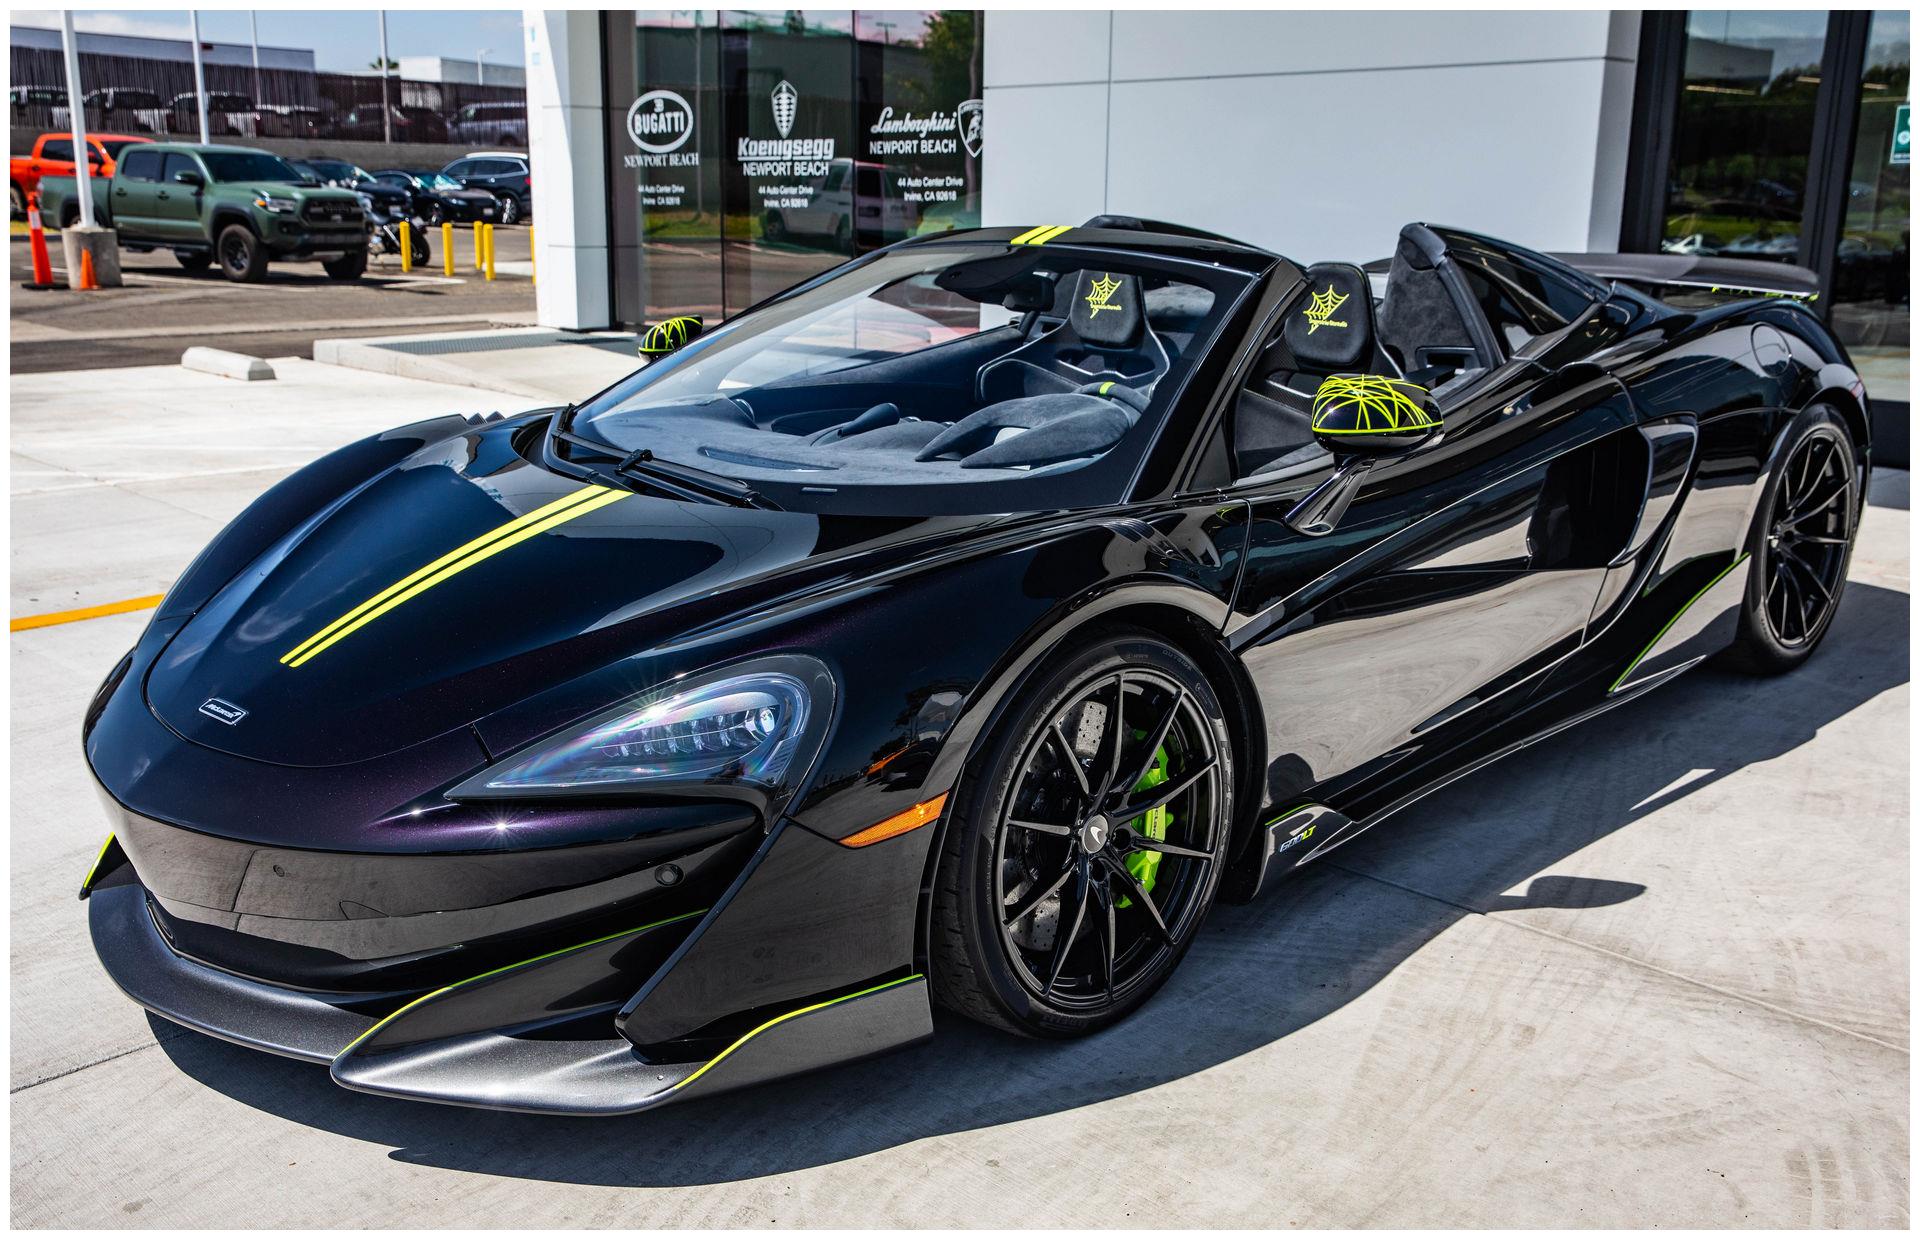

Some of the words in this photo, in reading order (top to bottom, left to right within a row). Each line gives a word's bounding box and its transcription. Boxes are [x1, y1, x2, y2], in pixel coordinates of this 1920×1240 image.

[634, 111, 685, 135] BUGATTI
[870, 106, 957, 138] Lamborghini
[738, 137, 834, 160] Koenigsegg
[869, 140, 919, 155] NEWPORT
[920, 139, 957, 154] BEACH
[624, 153, 668, 168] NEWPORT
[669, 152, 699, 166] BEACH
[743, 161, 792, 176] NEWPORT
[793, 161, 829, 176] BEACH
[897, 178, 906, 187] 44
[907, 178, 922, 187] Auto
[923, 177, 945, 187] Center
[946, 176, 964, 186] Drive
[766, 186, 779, 195] Auto
[780, 185, 798, 195] Center
[799, 185, 814, 195] Drive
[924, 191, 935, 201] CA
[657, 197, 666, 205] CA
[781, 198, 790, 208] CA
